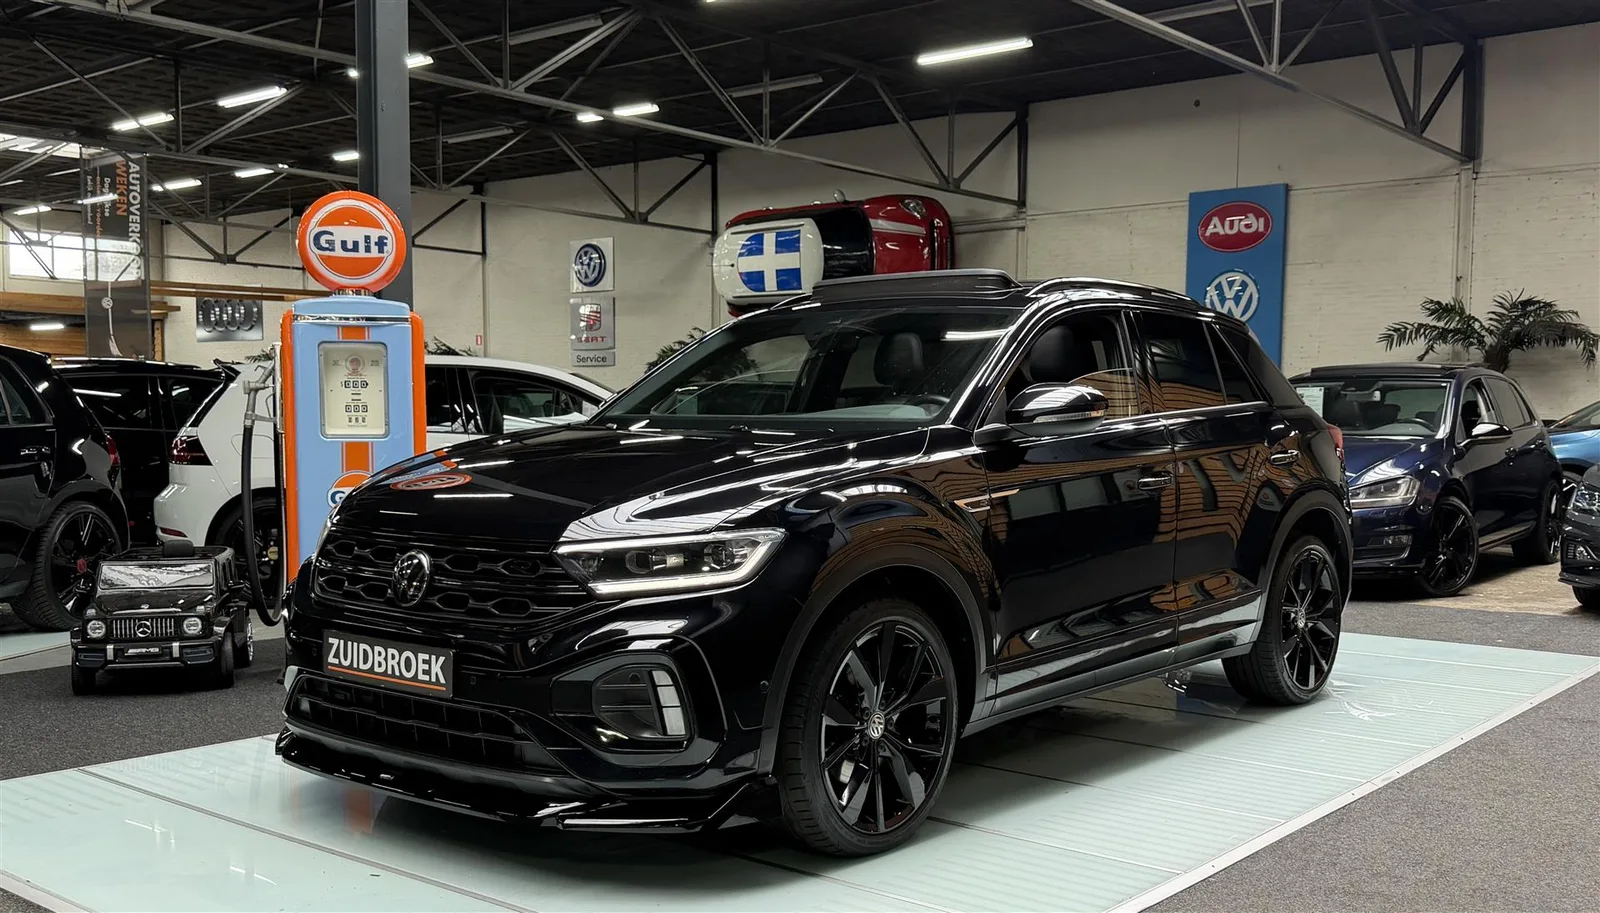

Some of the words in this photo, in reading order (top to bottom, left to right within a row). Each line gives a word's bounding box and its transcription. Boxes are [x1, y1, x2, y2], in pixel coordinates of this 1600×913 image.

[115, 160, 128, 216] WEKEN
[312, 230, 388, 254] Gulf
[576, 354, 607, 363] Service
[327, 637, 446, 684] ZUIDBROEK
